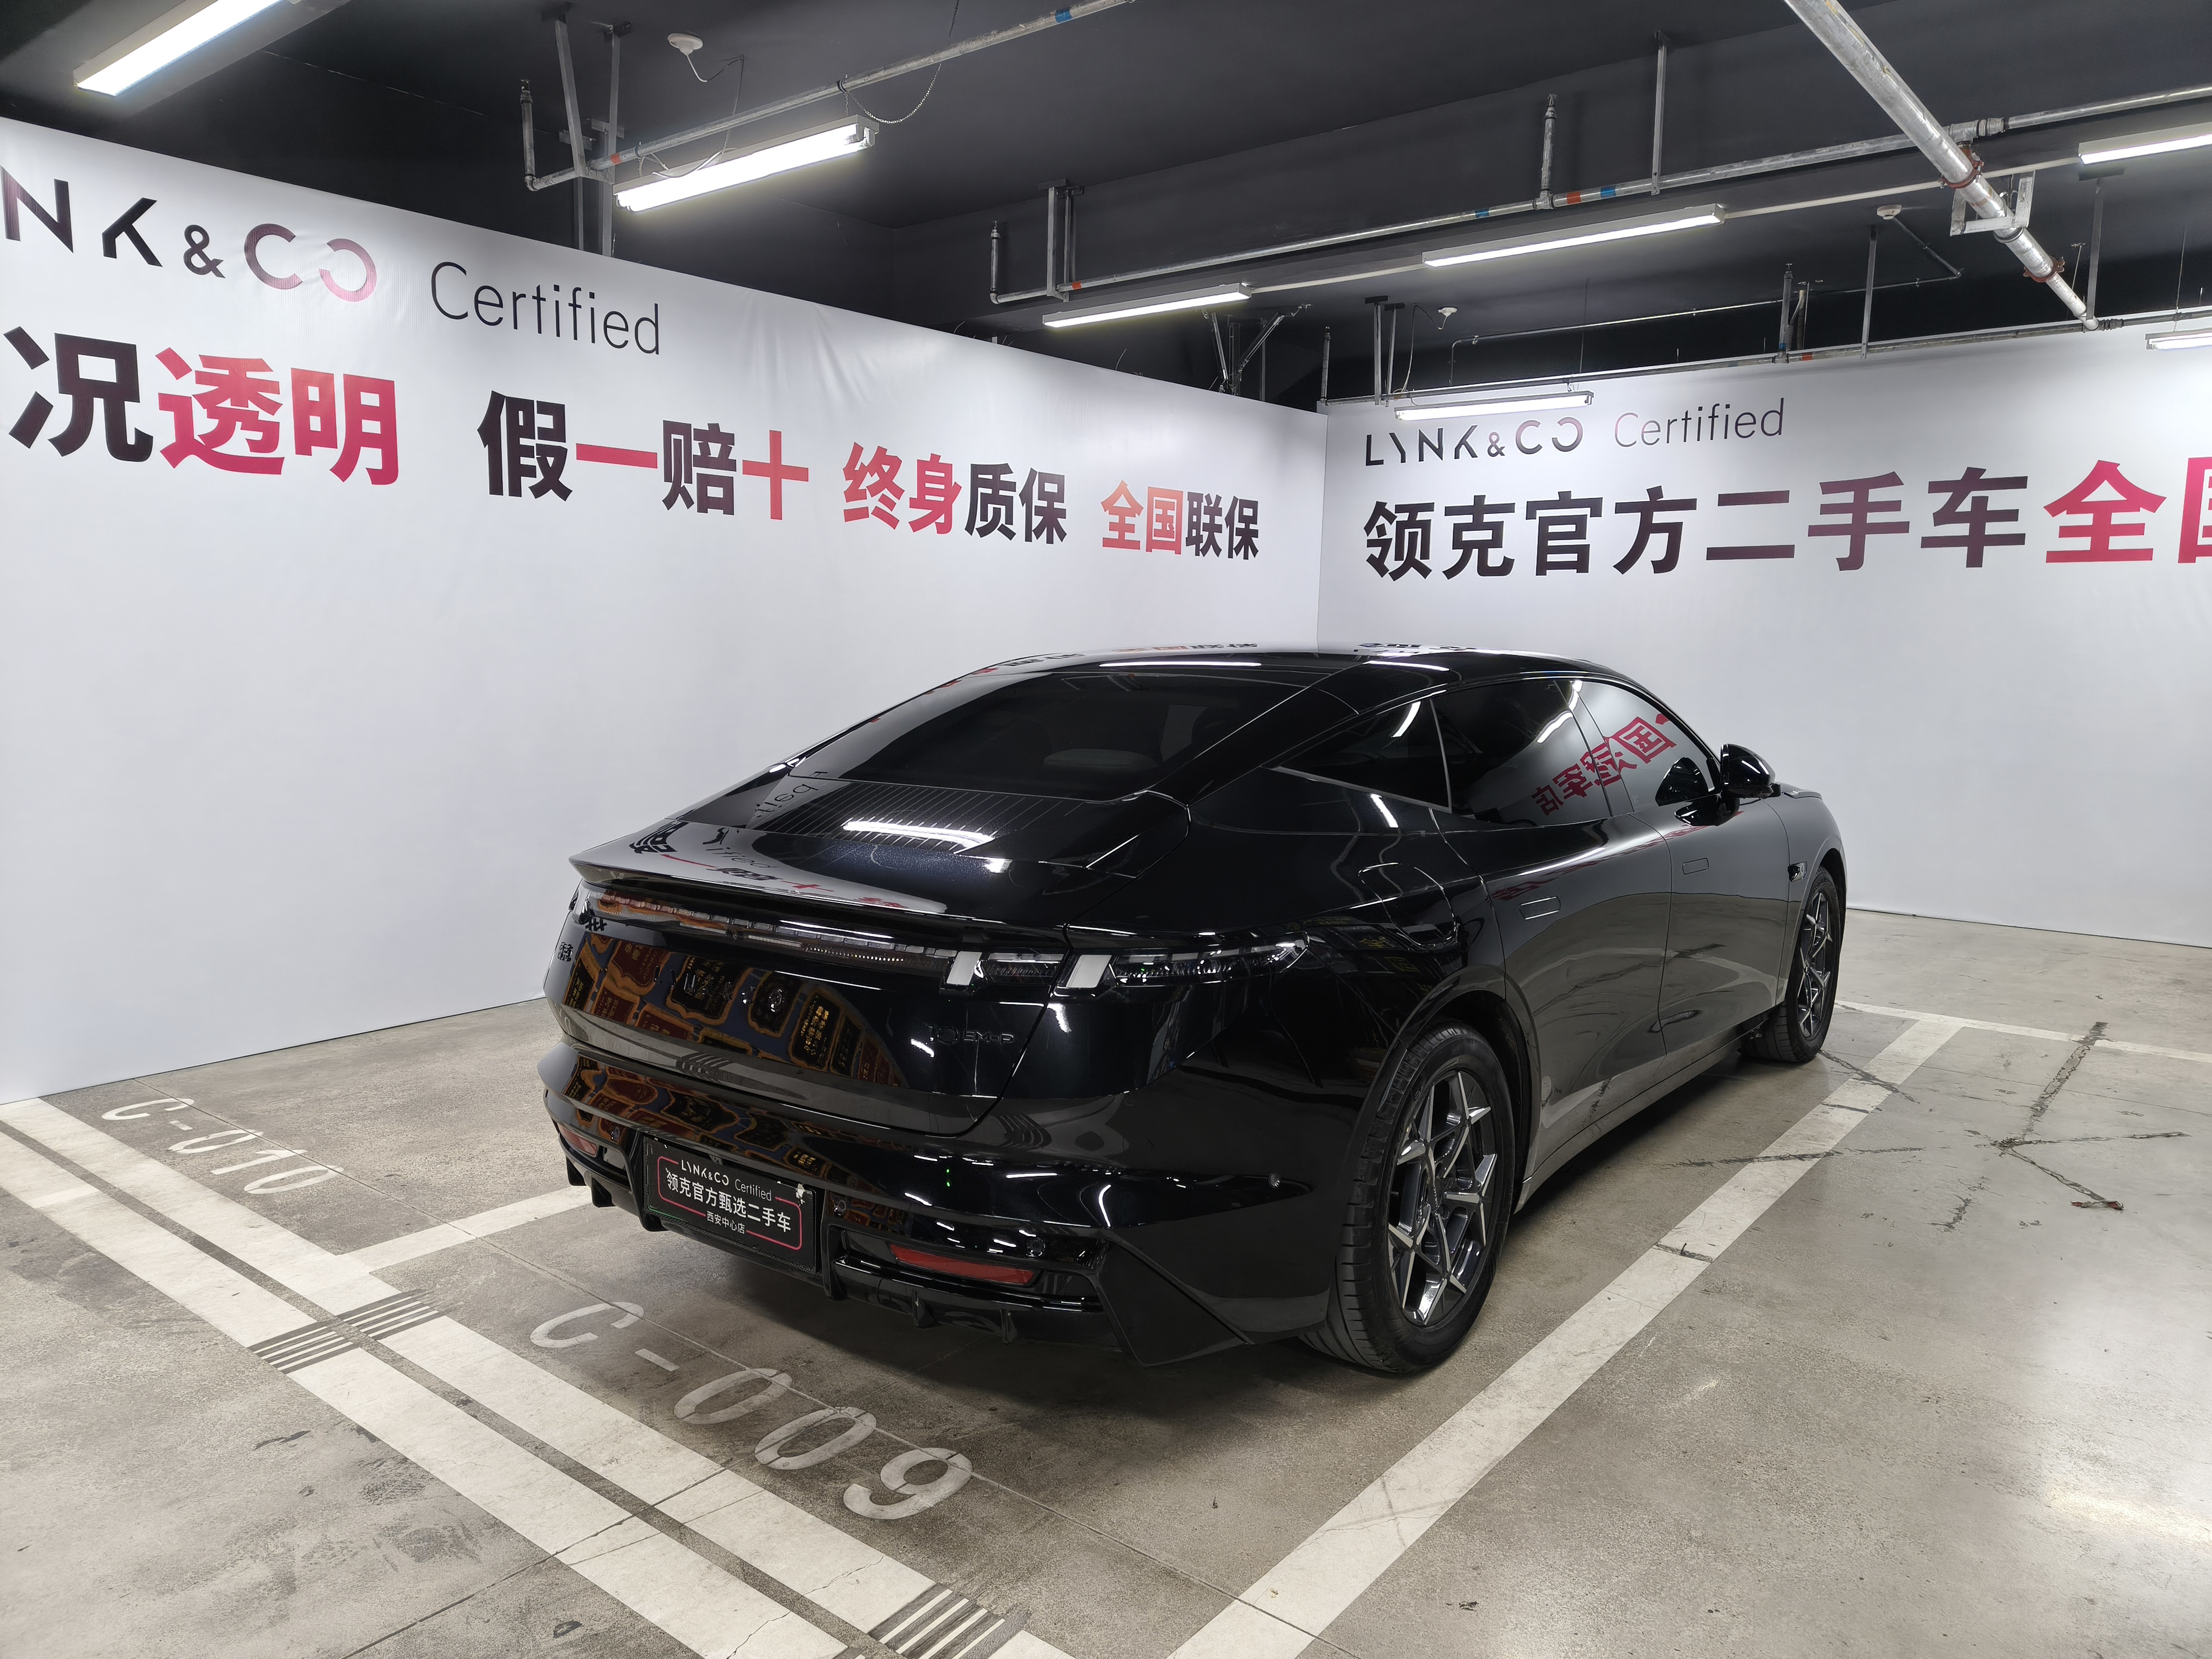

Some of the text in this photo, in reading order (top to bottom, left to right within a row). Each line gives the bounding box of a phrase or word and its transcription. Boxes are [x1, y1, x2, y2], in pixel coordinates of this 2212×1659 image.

[430, 261, 660, 355] Certified
[3, 326, 1259, 560] 况透明 假一赔十 终身质保 全国联保
[1614, 397, 1785, 448] Certified
[101, 1097, 344, 1195] C-010
[666, 1171, 791, 1232] 领克官方甄选二手车
[706, 1210, 746, 1235] 西安中心店
[734, 1179, 772, 1202] Certified
[529, 1301, 973, 1520] C-009
